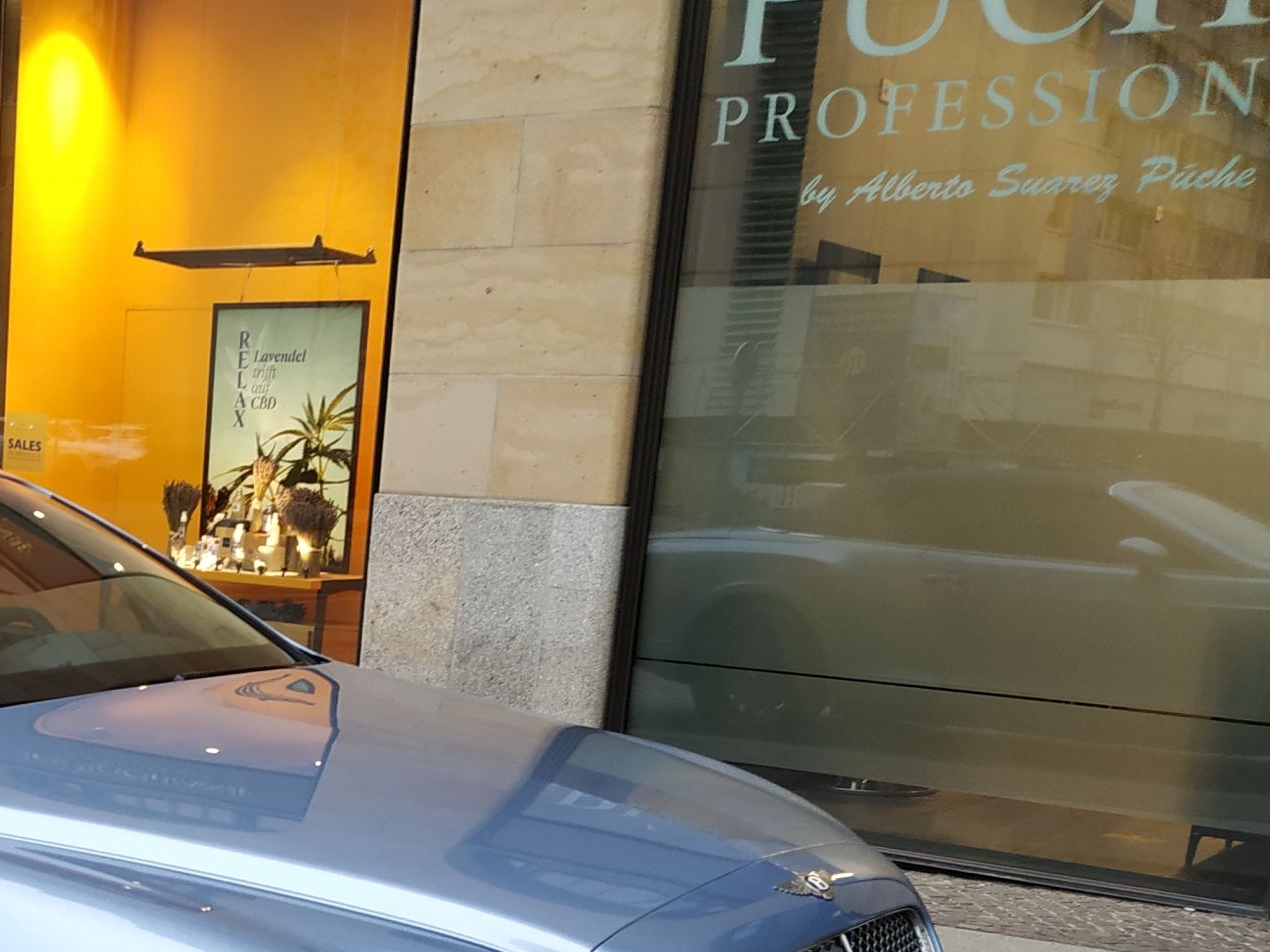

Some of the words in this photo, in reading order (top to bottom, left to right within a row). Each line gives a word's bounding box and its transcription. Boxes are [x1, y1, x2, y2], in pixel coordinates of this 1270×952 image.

[800, 174, 836, 214] by
[845, 170, 975, 206] Alberto
[988, 163, 1119, 204] Suarez
[253, 349, 307, 363] Lavendel
[252, 364, 277, 381] trifft
[250, 380, 271, 397] auf
[250, 396, 277, 410] CBD
[8, 438, 42, 452] SALES
